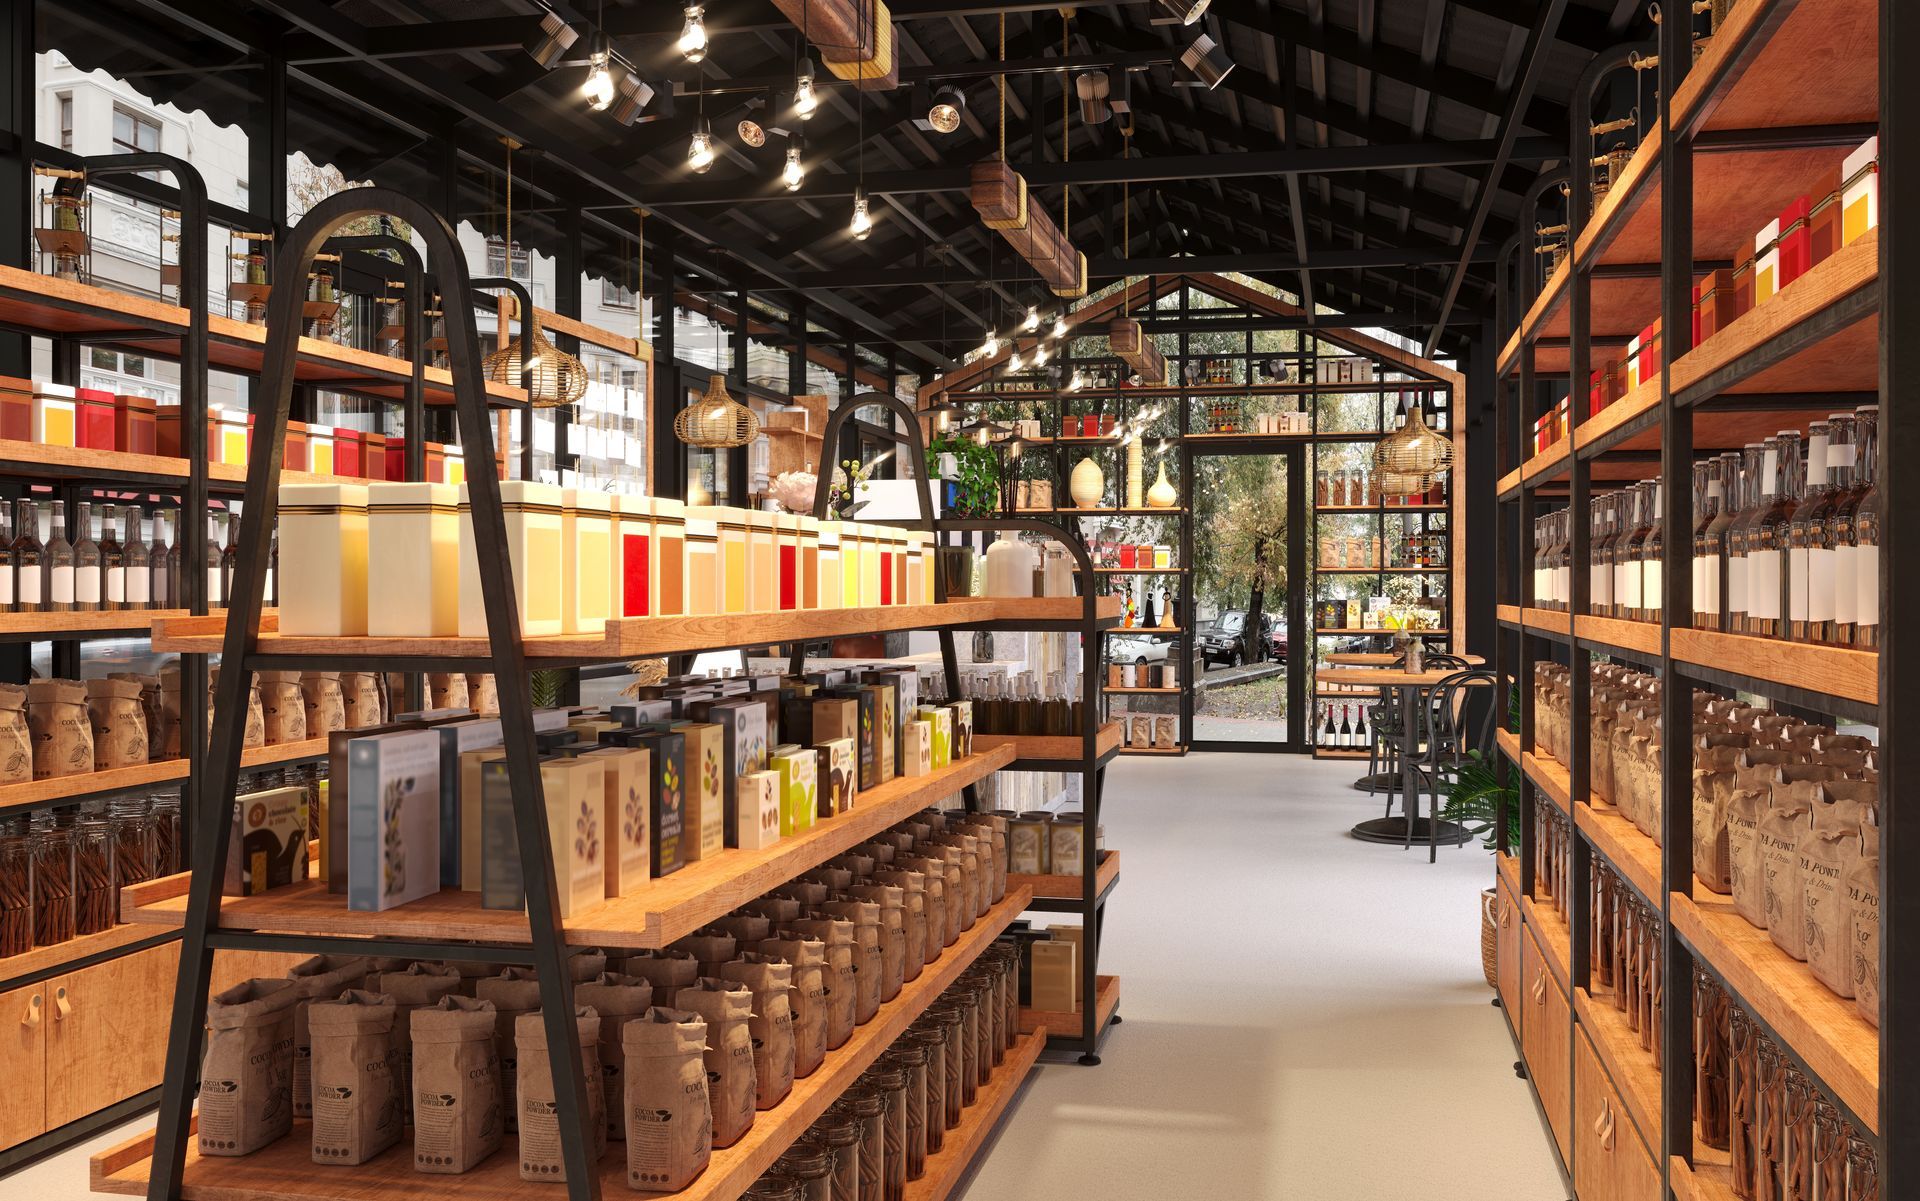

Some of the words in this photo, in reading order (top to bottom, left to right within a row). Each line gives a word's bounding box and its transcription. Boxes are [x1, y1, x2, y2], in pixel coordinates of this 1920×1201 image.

[526, 1100, 546, 1108] COCOA
[526, 1106, 551, 1115] POWDER
[634, 1107, 655, 1116] COCOA
[634, 1114, 661, 1123] POWDER
